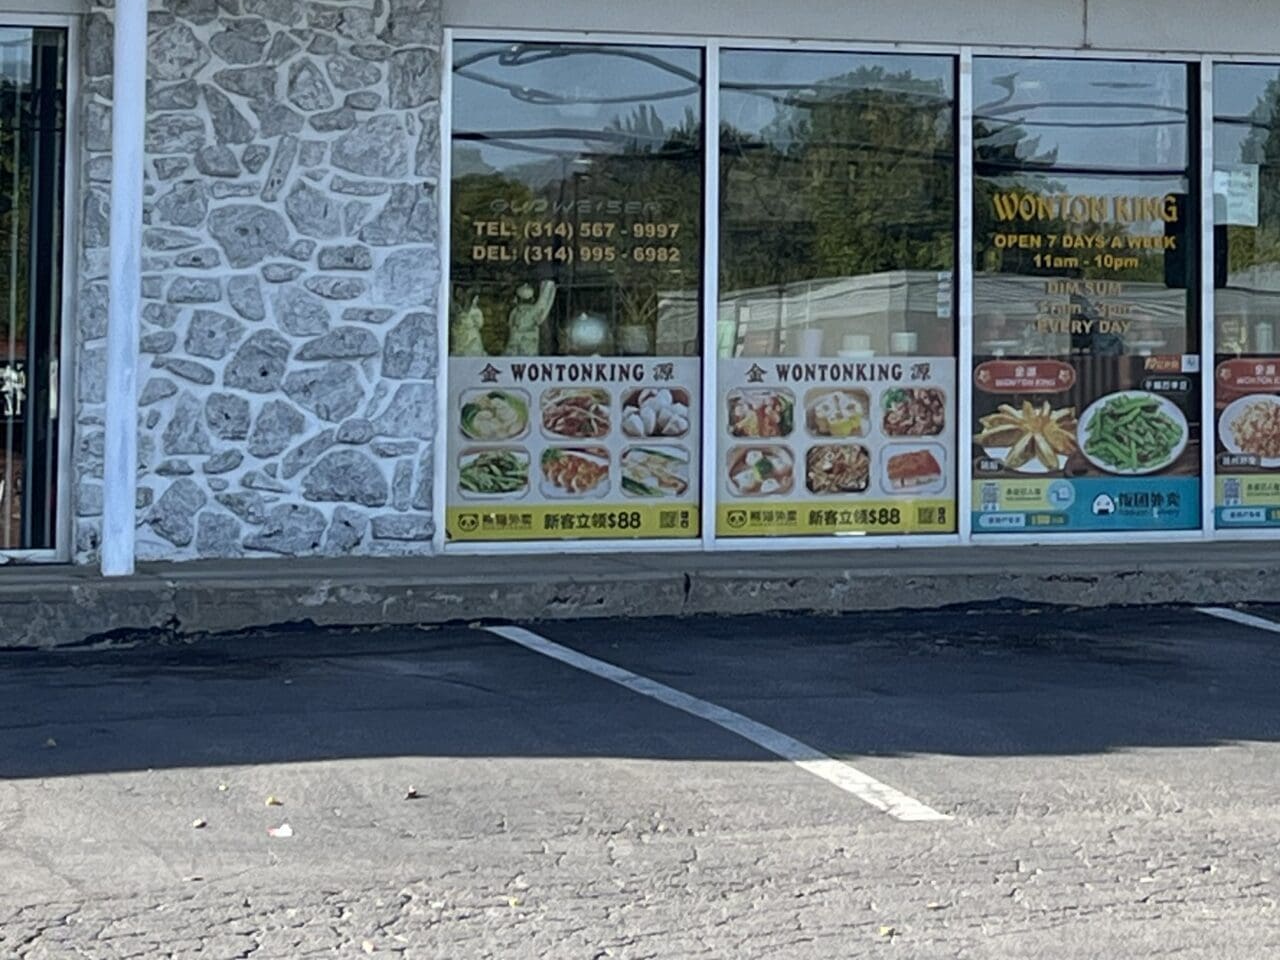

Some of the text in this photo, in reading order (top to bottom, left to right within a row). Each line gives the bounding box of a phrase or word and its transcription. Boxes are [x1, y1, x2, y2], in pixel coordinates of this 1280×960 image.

[992, 193, 1179, 224] WONTON KING
[473, 221, 517, 236] TEL:
[523, 221, 574, 239] (314)
[580, 223, 615, 237] 567
[633, 223, 680, 238] 9997
[994, 234, 1176, 249] OPEN 7 DAYS A WEEK
[472, 245, 517, 261] DEL:
[523, 246, 574, 264] (314)
[580, 247, 615, 261] 995
[633, 247, 680, 262] 6982
[1033, 254, 1079, 268] 11am
[1095, 254, 1139, 271] 10pm
[1100, 320, 1132, 334] DAY
[478, 362, 502, 383] 金
[511, 363, 644, 382] WONTONKING
[745, 362, 767, 383] 金
[775, 363, 903, 382] WONTONKING
